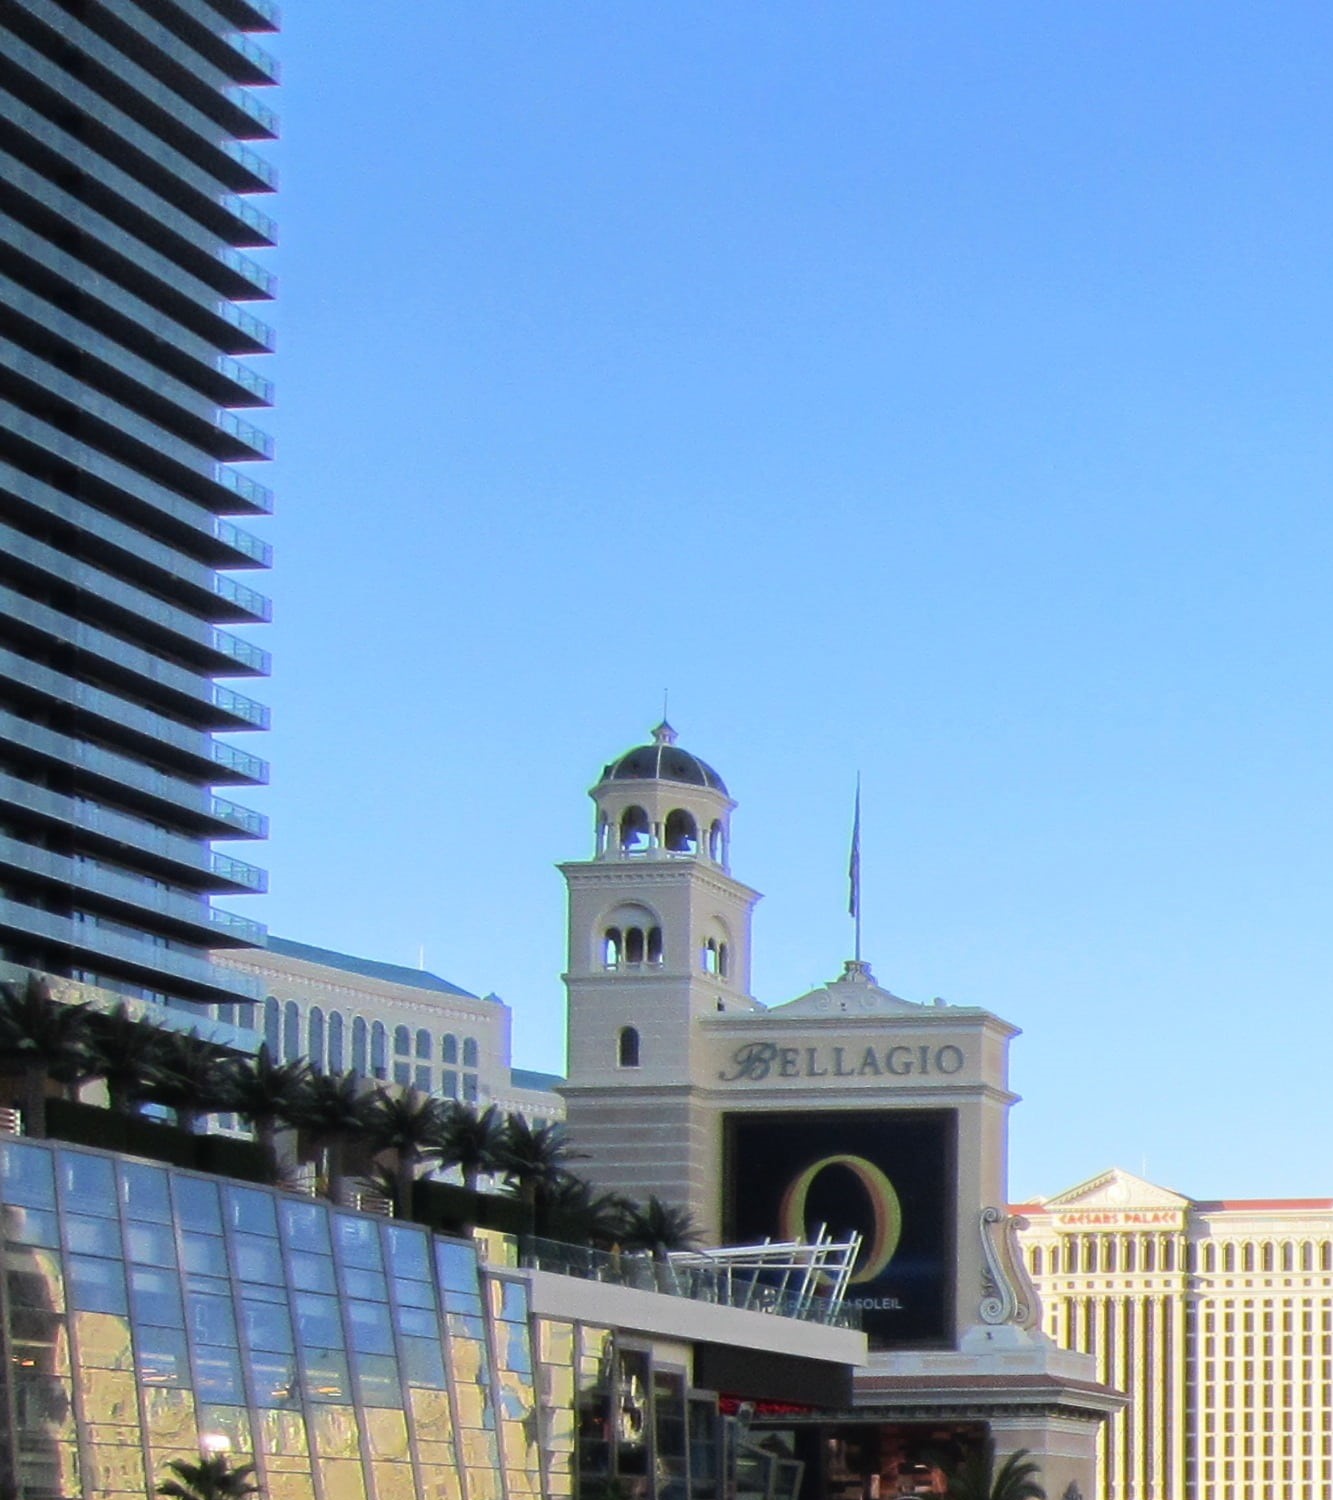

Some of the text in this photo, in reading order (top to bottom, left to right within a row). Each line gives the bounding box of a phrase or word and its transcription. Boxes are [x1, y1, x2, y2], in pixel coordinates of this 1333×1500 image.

[718, 1042, 965, 1082] BELLAGIO
[1059, 1213, 1176, 1224] CAESARS PALACE
[855, 1298, 903, 1309] SOLEIL
